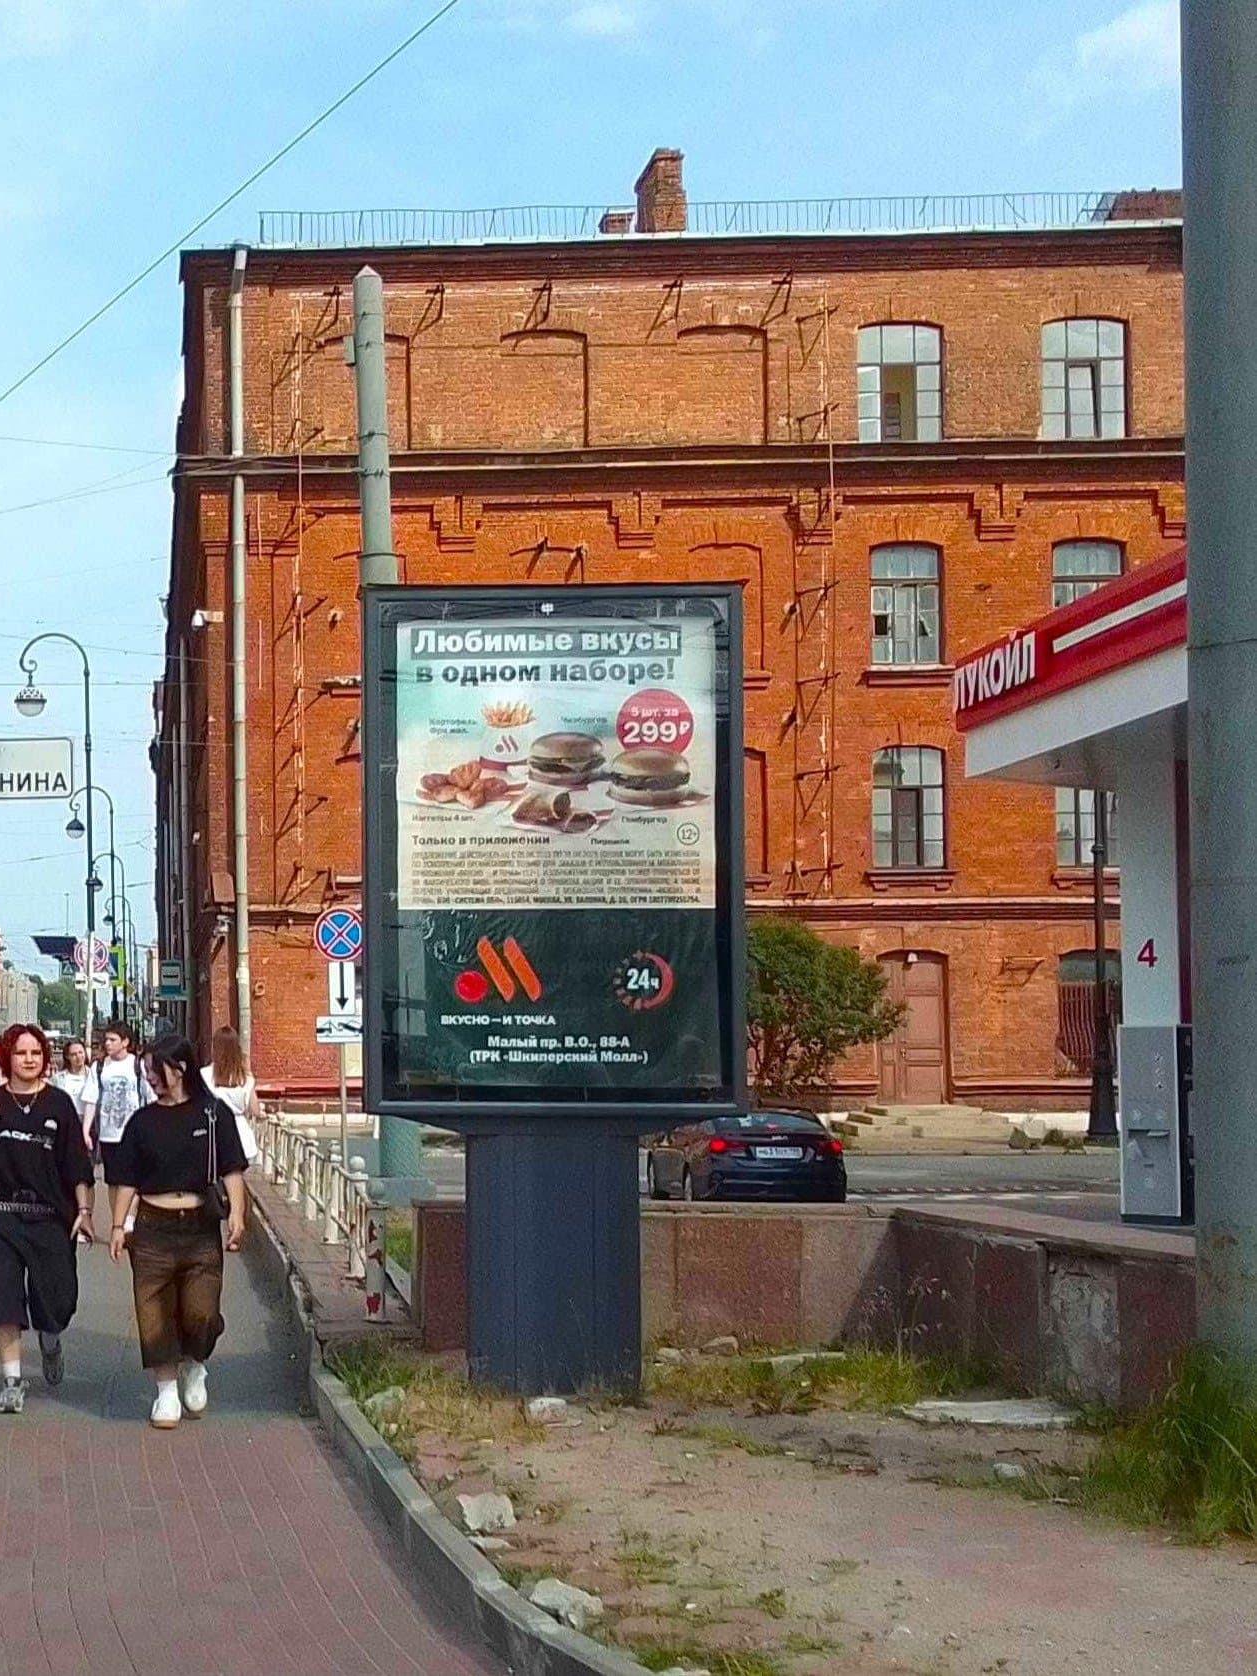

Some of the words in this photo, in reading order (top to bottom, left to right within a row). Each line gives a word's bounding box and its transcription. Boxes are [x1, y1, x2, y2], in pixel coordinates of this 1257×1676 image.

[414, 629, 573, 653] Любимые
[581, 631, 678, 656] вкусы
[416, 665, 433, 682] в
[441, 664, 541, 687] одном
[549, 658, 675, 685] наборе!
[952, 630, 1036, 713] ЛУКОЙЛ
[412, 834, 456, 846] Только
[459, 836, 466, 845] в
[469, 835, 551, 847] приложении
[681, 828, 697, 840] 12+
[1137, 938, 1158, 968] 4
[440, 1015, 491, 1026] ВКУСНО
[502, 1015, 513, 1025] И
[514, 1015, 557, 1026] ТОЧКА
[487, 1034, 538, 1048] Малый
[539, 1037, 562, 1050] пр.
[469, 1050, 501, 1064] (ТРК
